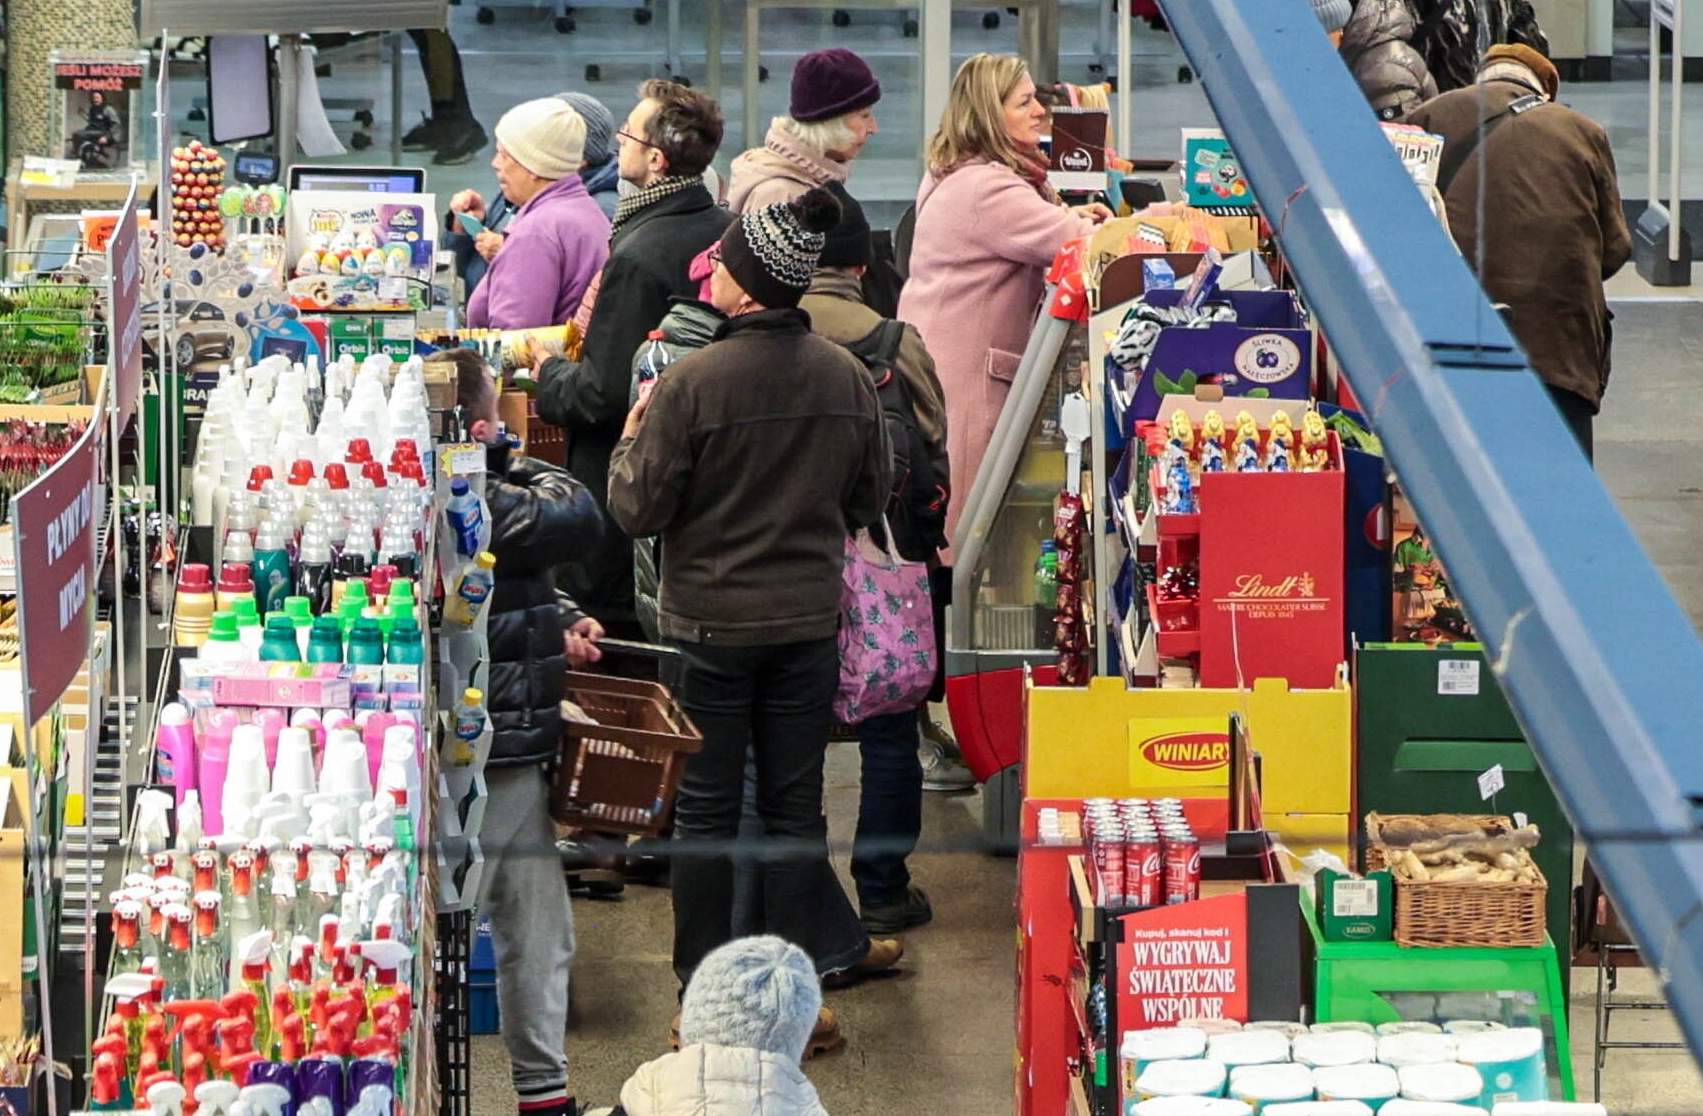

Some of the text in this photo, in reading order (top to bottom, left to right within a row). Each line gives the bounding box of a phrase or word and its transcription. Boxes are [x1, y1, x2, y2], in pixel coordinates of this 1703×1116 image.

[74, 78, 123, 91] POMÓŻ
[1228, 574, 1299, 597] Lindt
[1204, 927, 1223, 937] kod
[1133, 940, 1231, 966] WYGRYWAJ
[1129, 966, 1236, 997] ŚWIĄTECZNE
[1141, 993, 1224, 1023] WSPÓLNE
